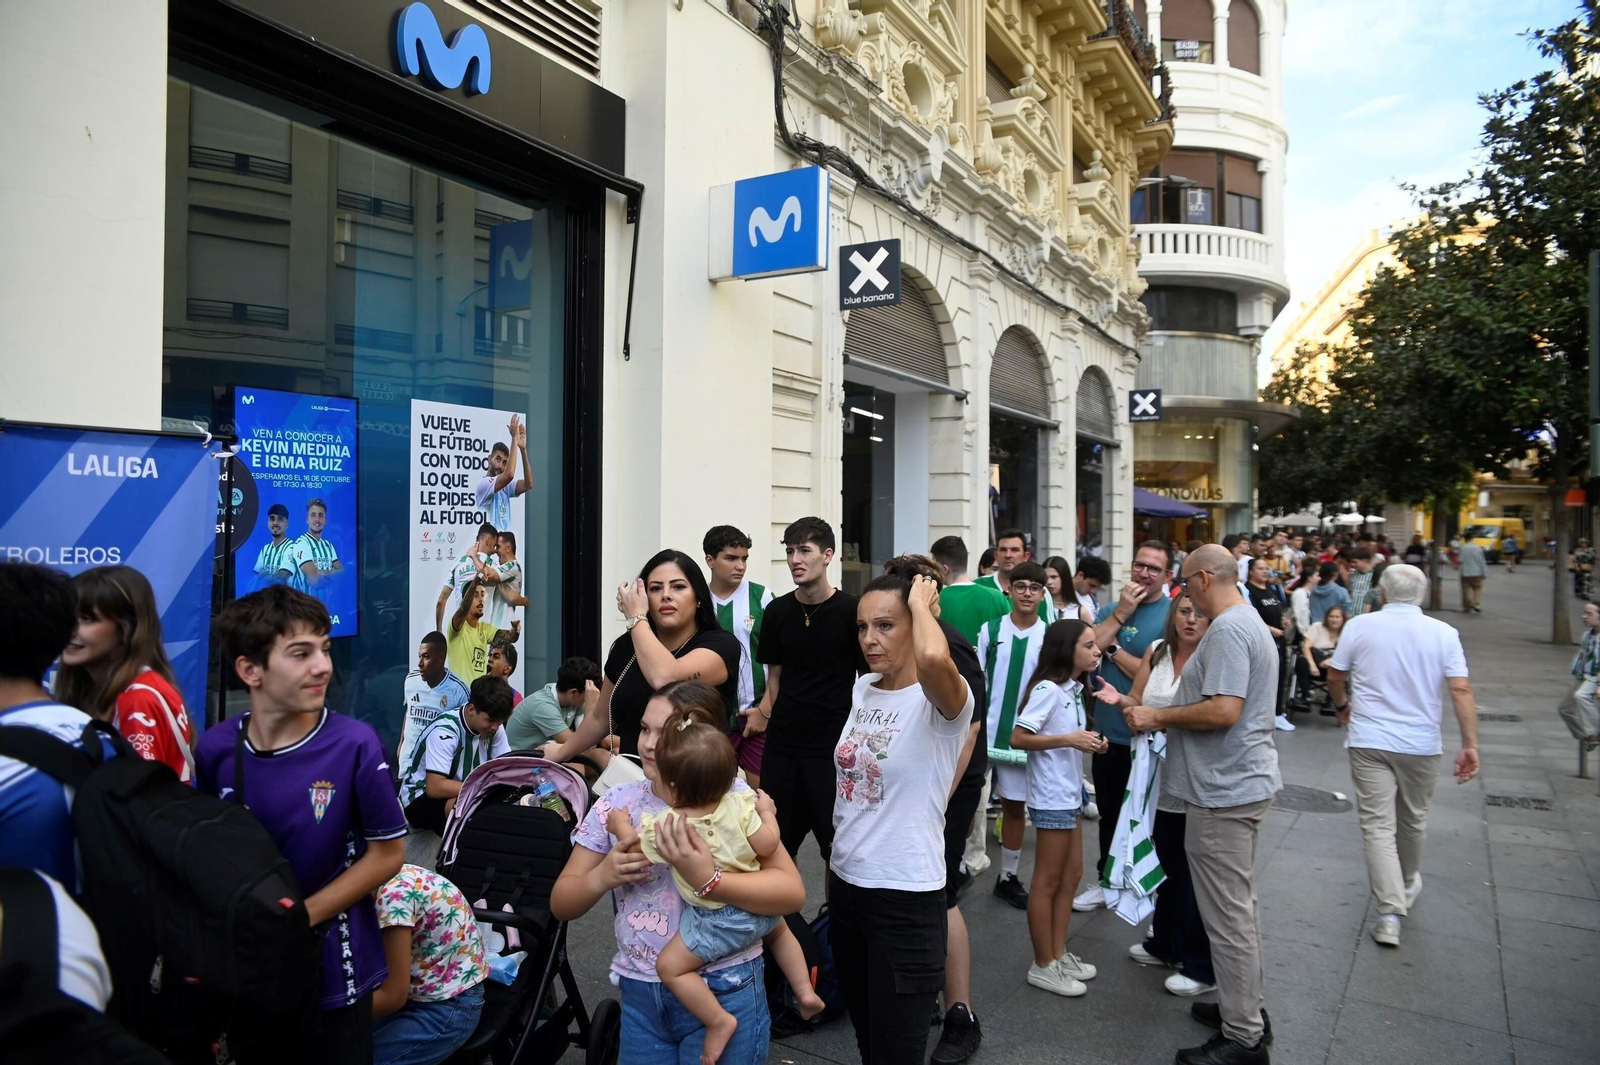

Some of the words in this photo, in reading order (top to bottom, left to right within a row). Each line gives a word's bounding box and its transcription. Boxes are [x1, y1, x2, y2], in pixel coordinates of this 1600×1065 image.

[844, 297, 862, 305] blue
[862, 293, 895, 303] banana
[420, 413, 471, 433] VUELVE
[253, 428, 273, 439] VEN
[275, 430, 283, 440] A
[285, 430, 334, 444] CONOCER
[335, 435, 343, 444] A
[421, 433, 437, 449] EL
[439, 431, 490, 453] FÚTBOL
[241, 438, 289, 454] KEVIN
[292, 442, 351, 458] MEDINA
[67, 453, 159, 478] LALIGA
[252, 454, 262, 467] E
[265, 454, 306, 470] ISMA
[309, 457, 343, 471] RUIZ
[420, 452, 451, 469] CON
[454, 455, 490, 471] TODO
[251, 472, 294, 481] ESPERAMOS
[321, 475, 350, 483] OCTUBRE
[420, 471, 439, 487] LO
[440, 472, 469, 490] QUE
[420, 490, 437, 506] LE
[438, 491, 476, 507] PIDES
[1155, 488, 1224, 500] ONOVIAS
[419, 510, 438, 525] AL
[439, 506, 488, 526] FÚTBOL
[410, 705, 441, 719] Emirat
